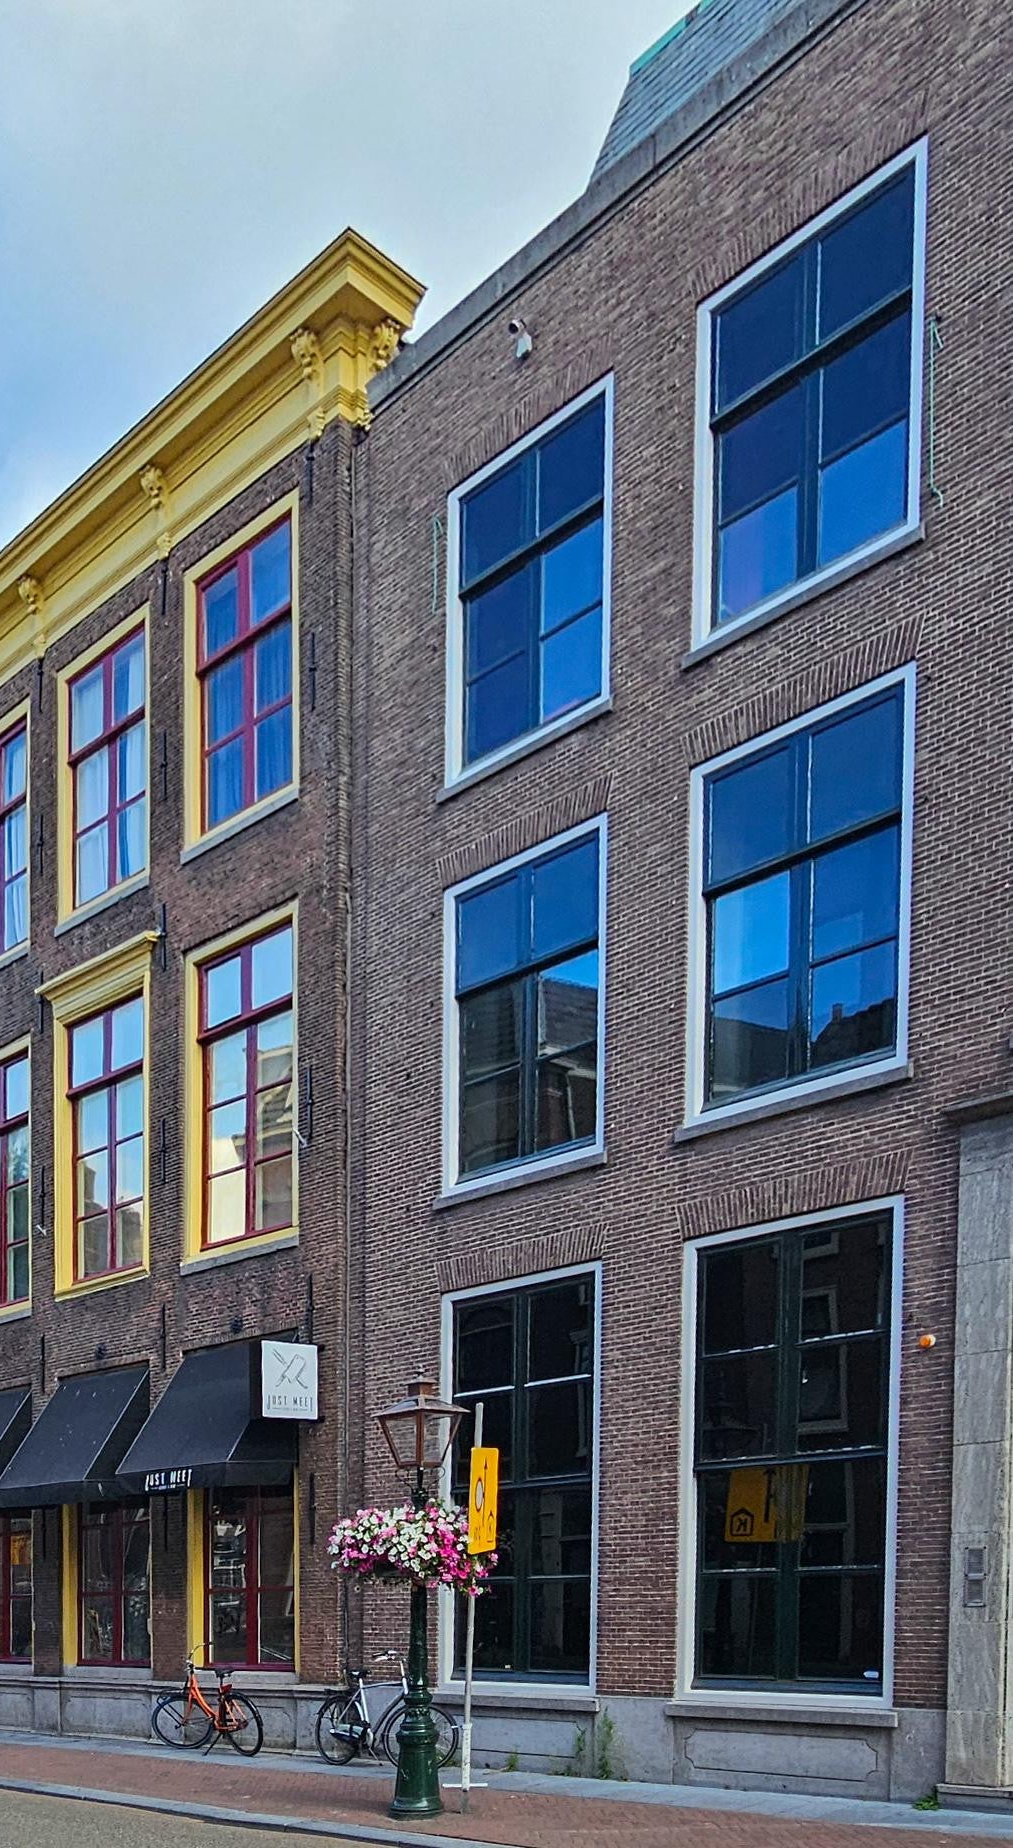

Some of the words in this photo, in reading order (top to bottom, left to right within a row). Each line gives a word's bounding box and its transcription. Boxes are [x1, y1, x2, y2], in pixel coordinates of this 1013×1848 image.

[267, 1395, 287, 1409] JUST
[293, 1396, 313, 1412] MEET
[145, 1472, 165, 1491] JUST
[170, 1469, 192, 1487] MEET
